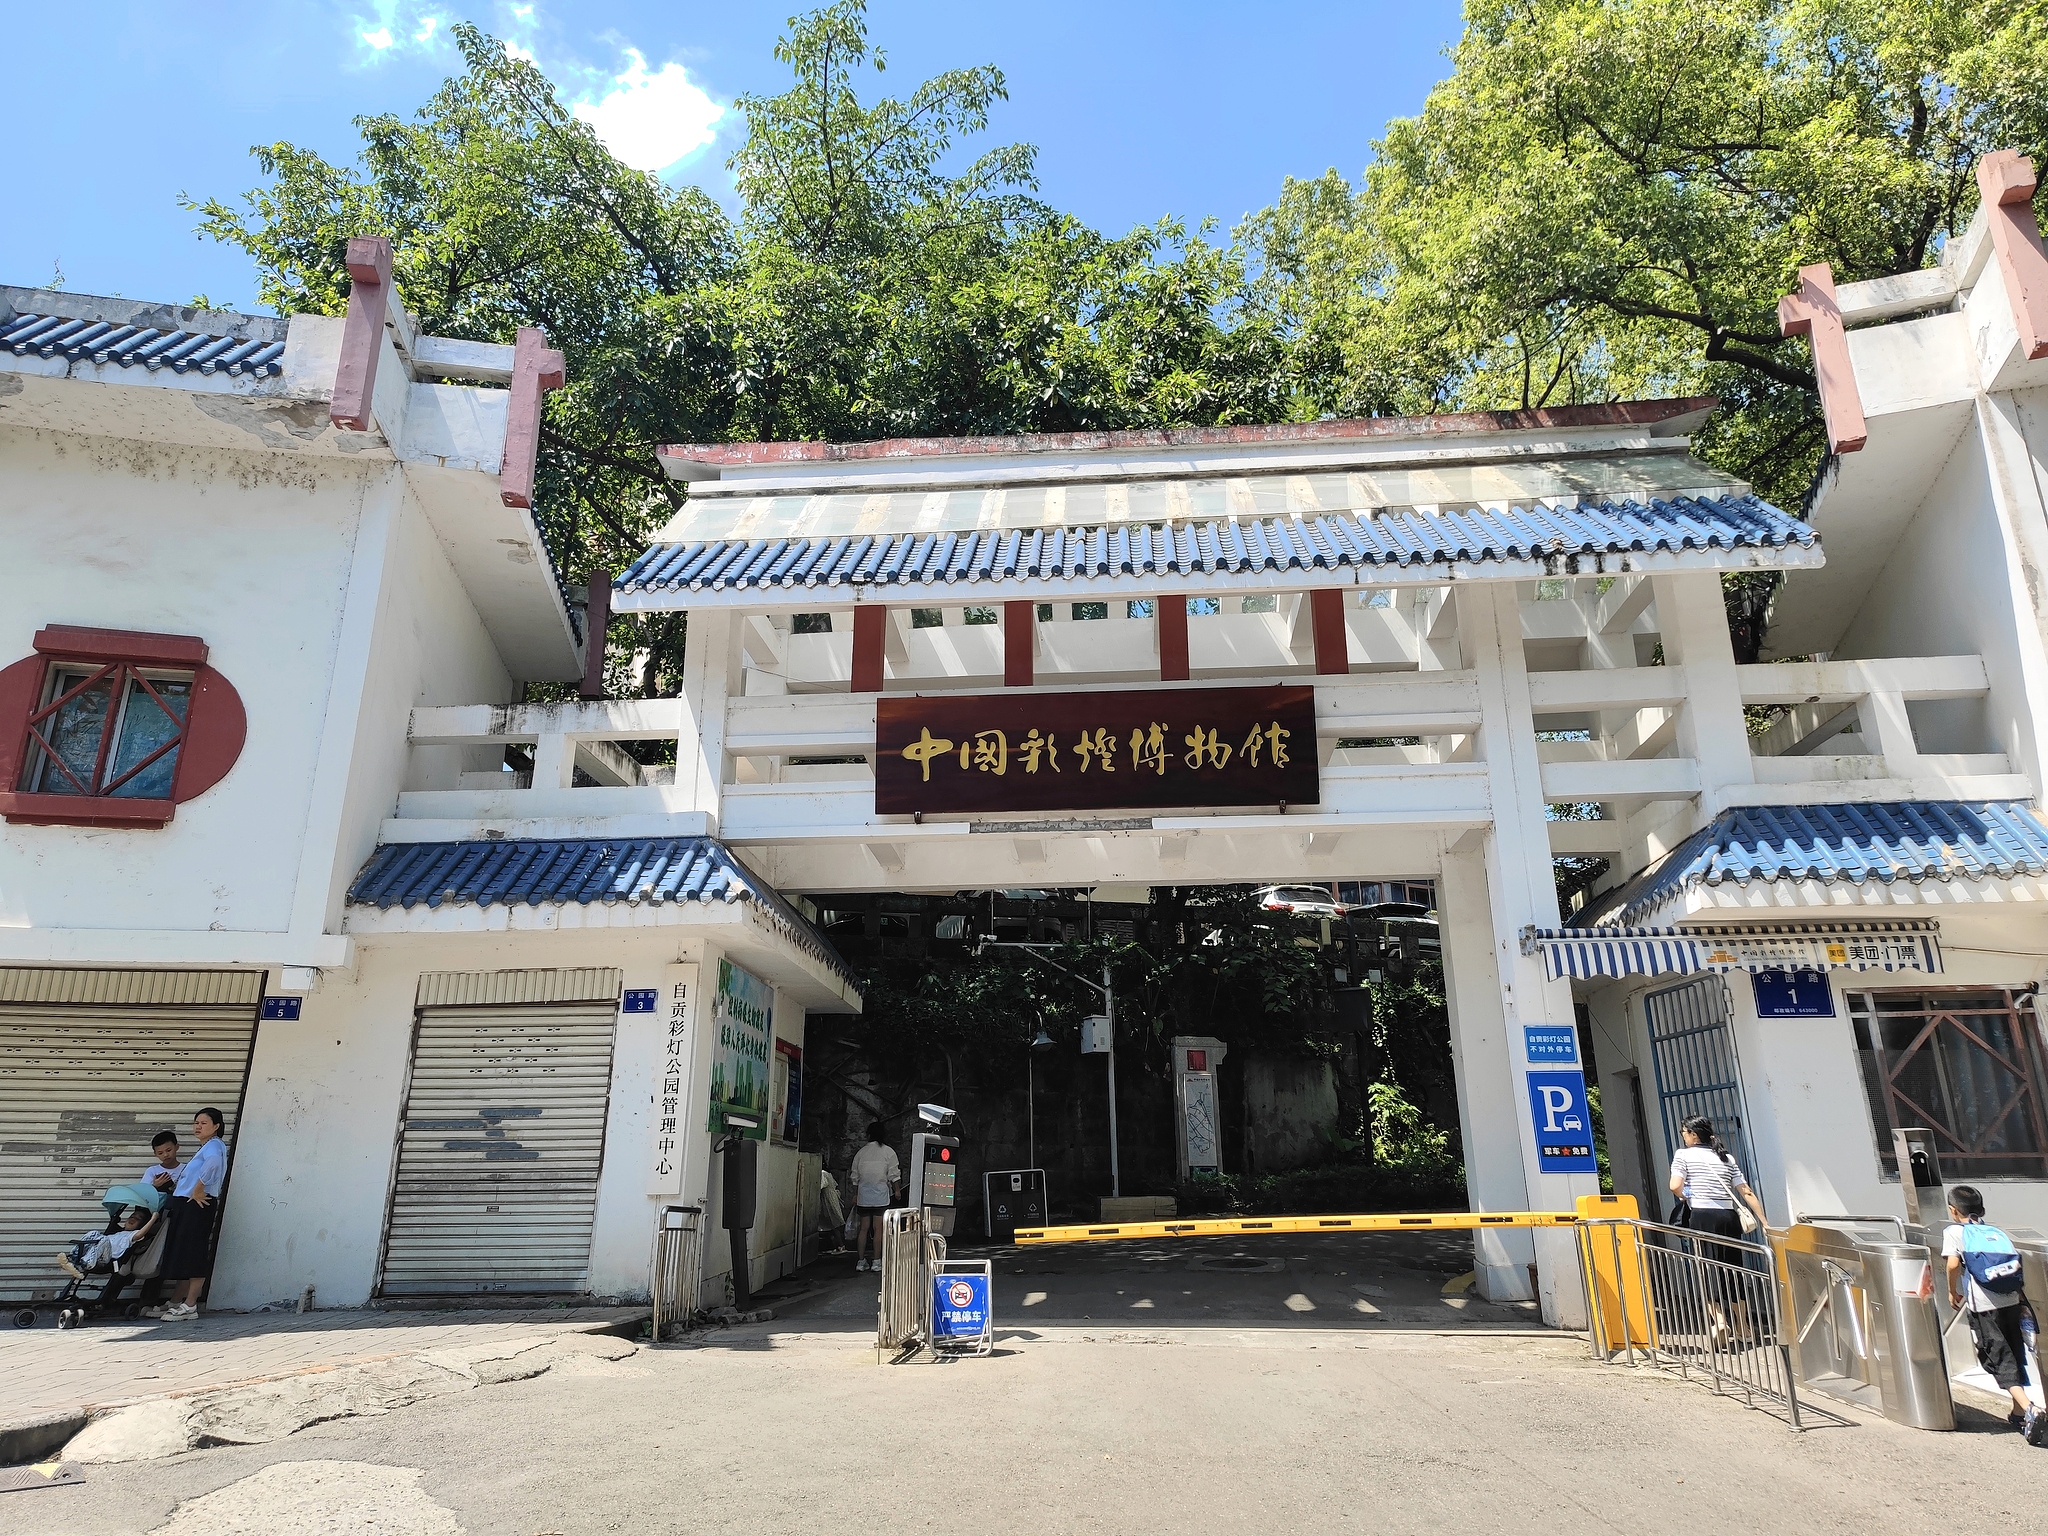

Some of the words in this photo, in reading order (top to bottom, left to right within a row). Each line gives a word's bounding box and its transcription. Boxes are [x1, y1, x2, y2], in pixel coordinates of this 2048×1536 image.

[1761, 973, 1819, 984] 公园路
[1787, 988, 1798, 1005] 1
[637, 1001, 644, 1010] 3
[278, 1009, 284, 1017] 5
[1529, 1035, 1571, 1043] 自贡彩灯公园
[1530, 1045, 1573, 1053] 不对外停车
[655, 982, 687, 1175] 自贡彩灯公园管理中心
[1537, 1086, 1573, 1132] P
[930, 1147, 937, 1159] P
[1544, 1147, 1561, 1155] 军车
[1572, 1147, 1589, 1155] 免费
[941, 1310, 982, 1323] 严禁停车
